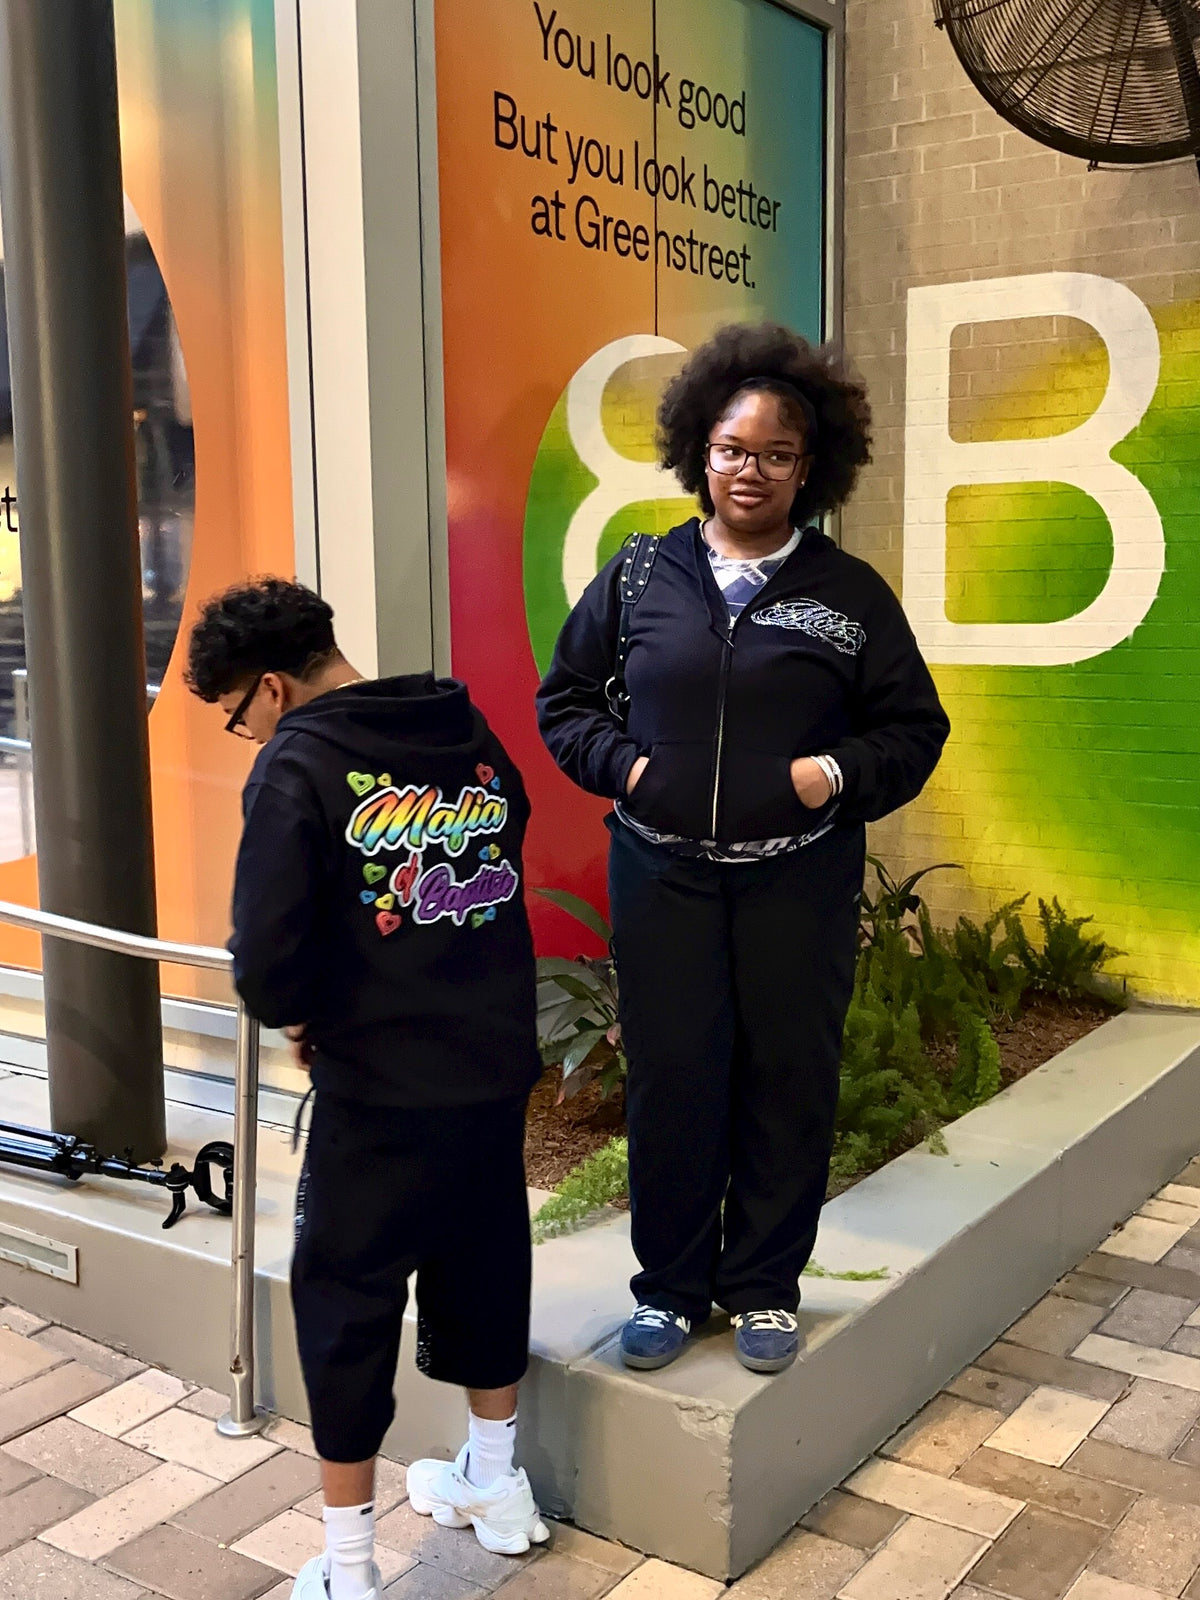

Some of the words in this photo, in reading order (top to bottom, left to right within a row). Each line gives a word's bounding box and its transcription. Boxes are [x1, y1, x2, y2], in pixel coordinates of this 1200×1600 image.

[533, 1, 595, 79] You
[606, 33, 672, 108] look
[678, 78, 746, 136] good
[493, 91, 558, 165] But
[565, 130, 623, 185] you
[634, 140, 696, 208] look
[703, 164, 781, 232] better
[531, 190, 565, 241] at
[575, 194, 756, 289] Greenstreet.
[902, 271, 1167, 666] B
[345, 784, 508, 857] Mafia
